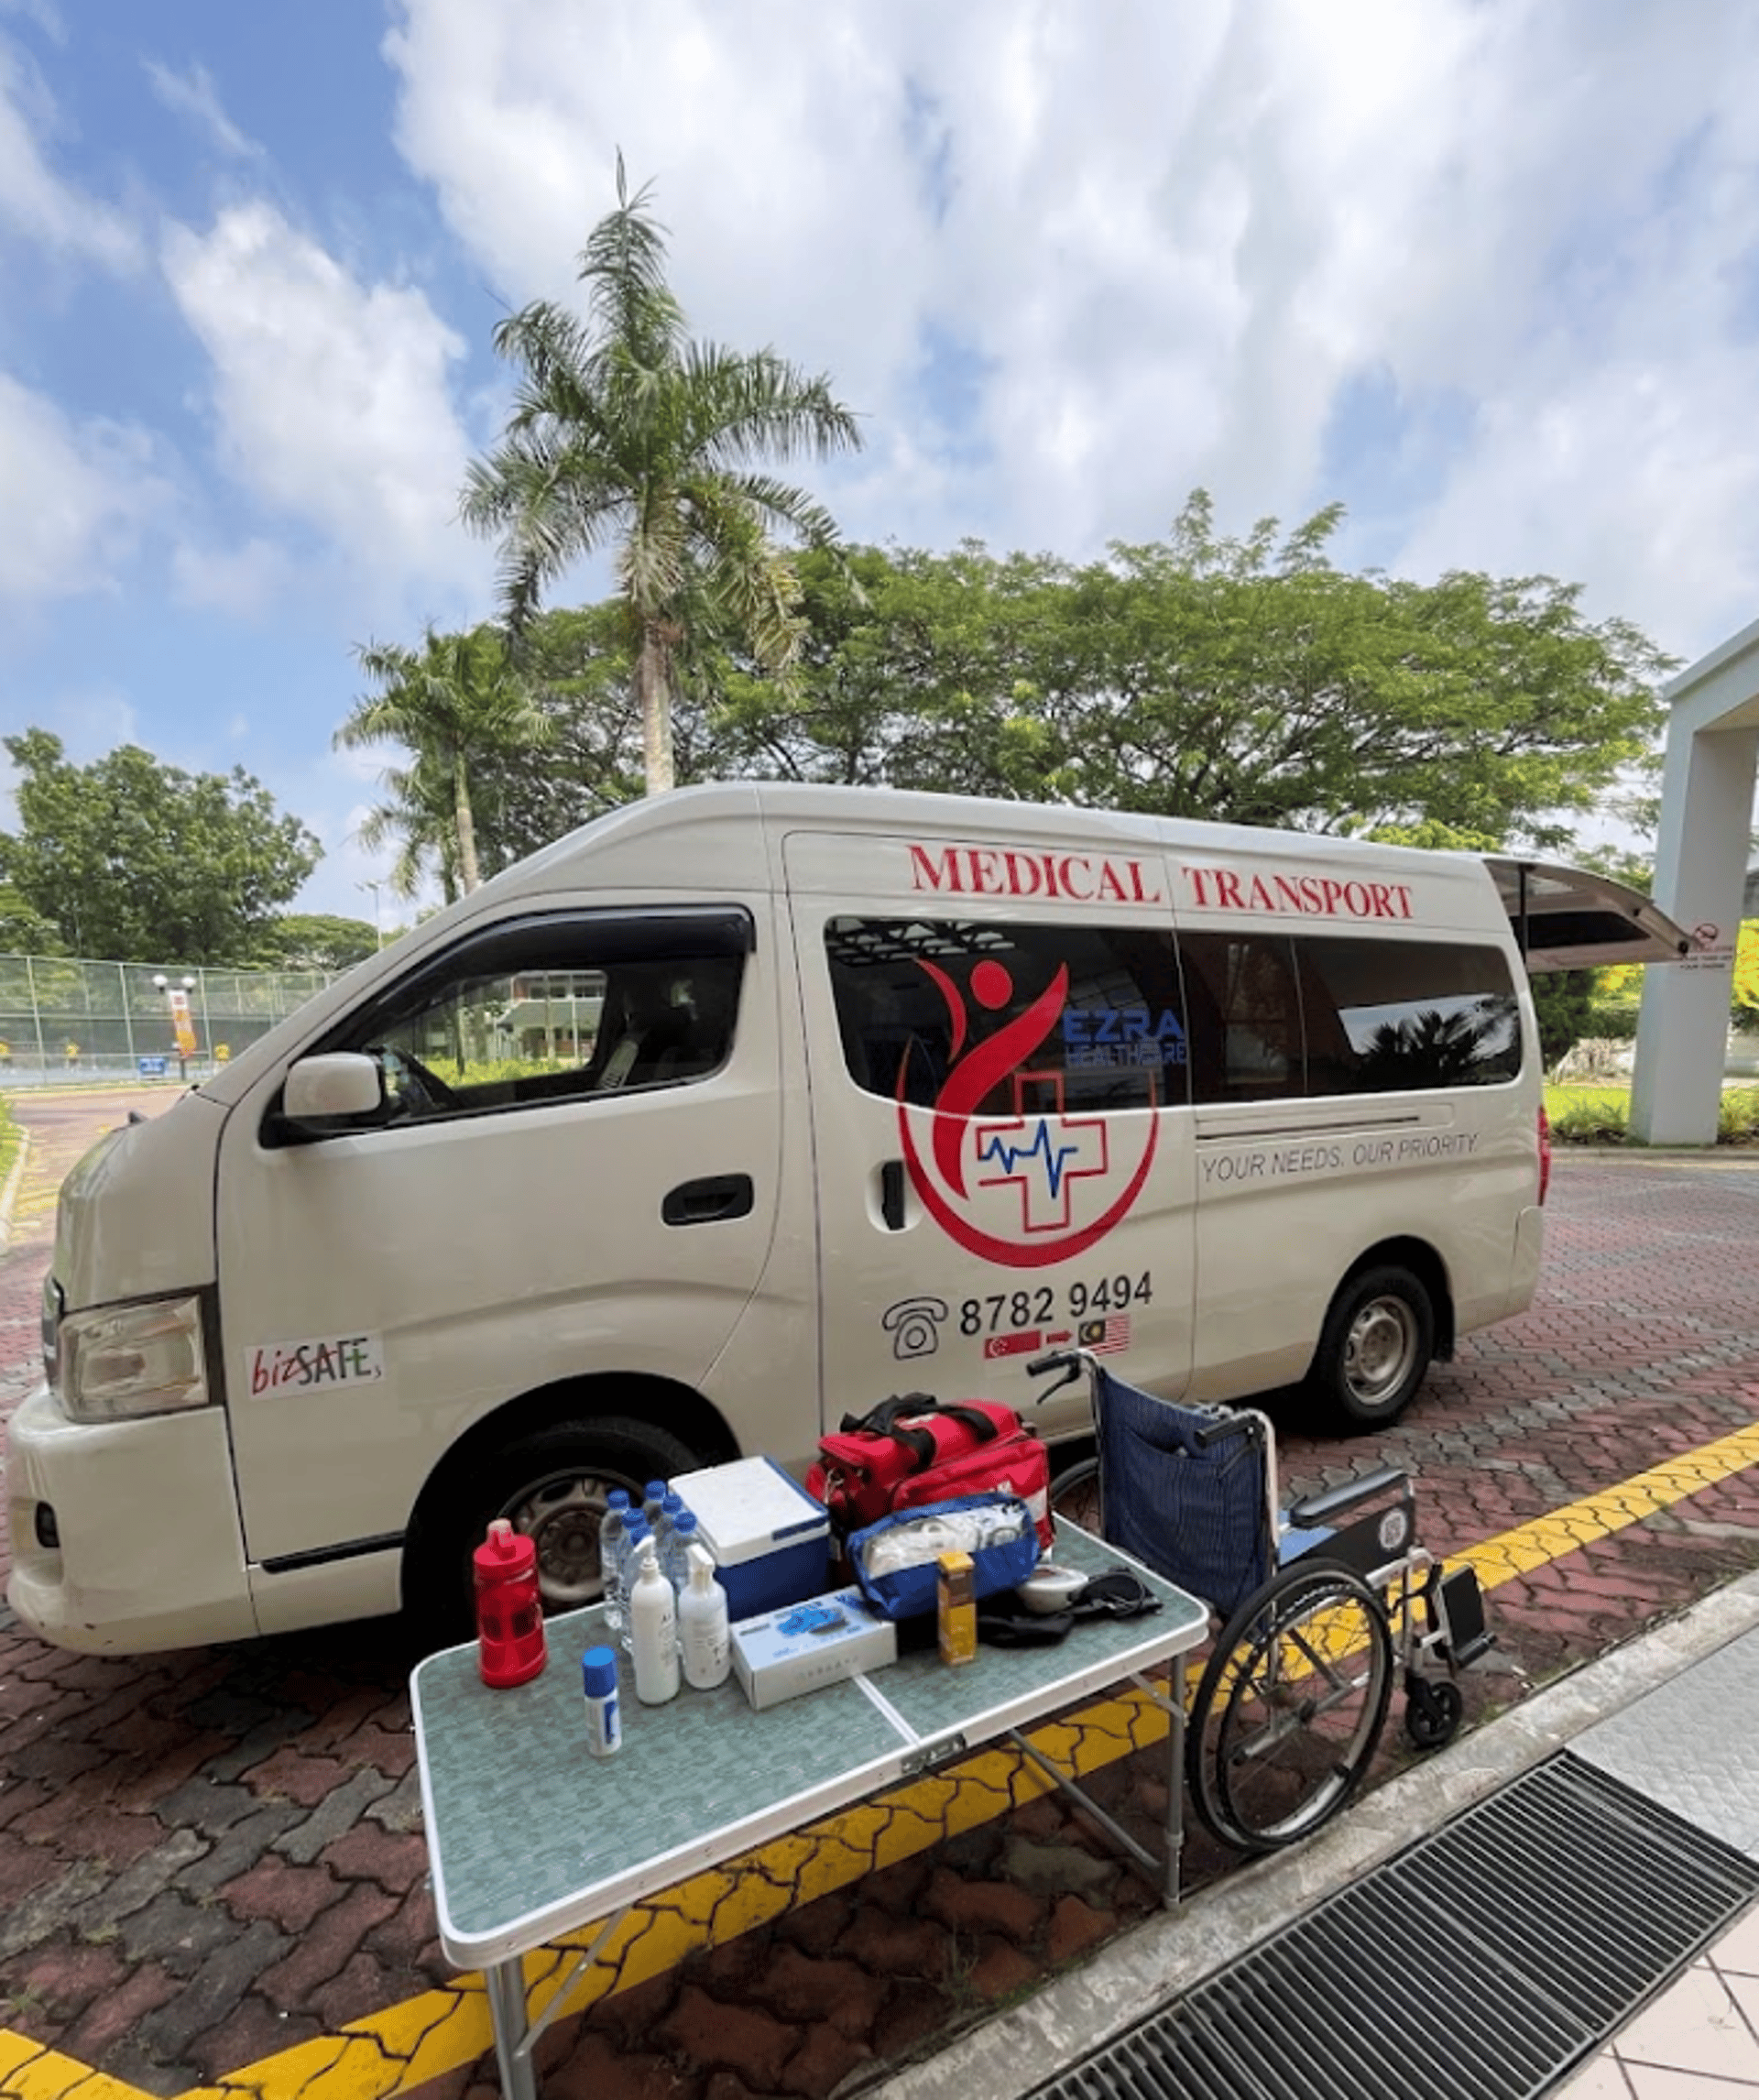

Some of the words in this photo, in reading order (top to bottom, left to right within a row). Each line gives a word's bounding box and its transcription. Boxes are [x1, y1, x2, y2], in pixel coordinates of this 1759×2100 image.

[906, 844, 1161, 903] MEDICAL
[1181, 866, 1415, 920] TRANSPORT
[1063, 1008, 1185, 1043] EZRA
[1201, 1153, 1265, 1183] YOUR
[1352, 1142, 1394, 1166] OUR
[959, 1285, 1054, 1337] 8782
[1068, 1269, 1153, 1318] 9494
